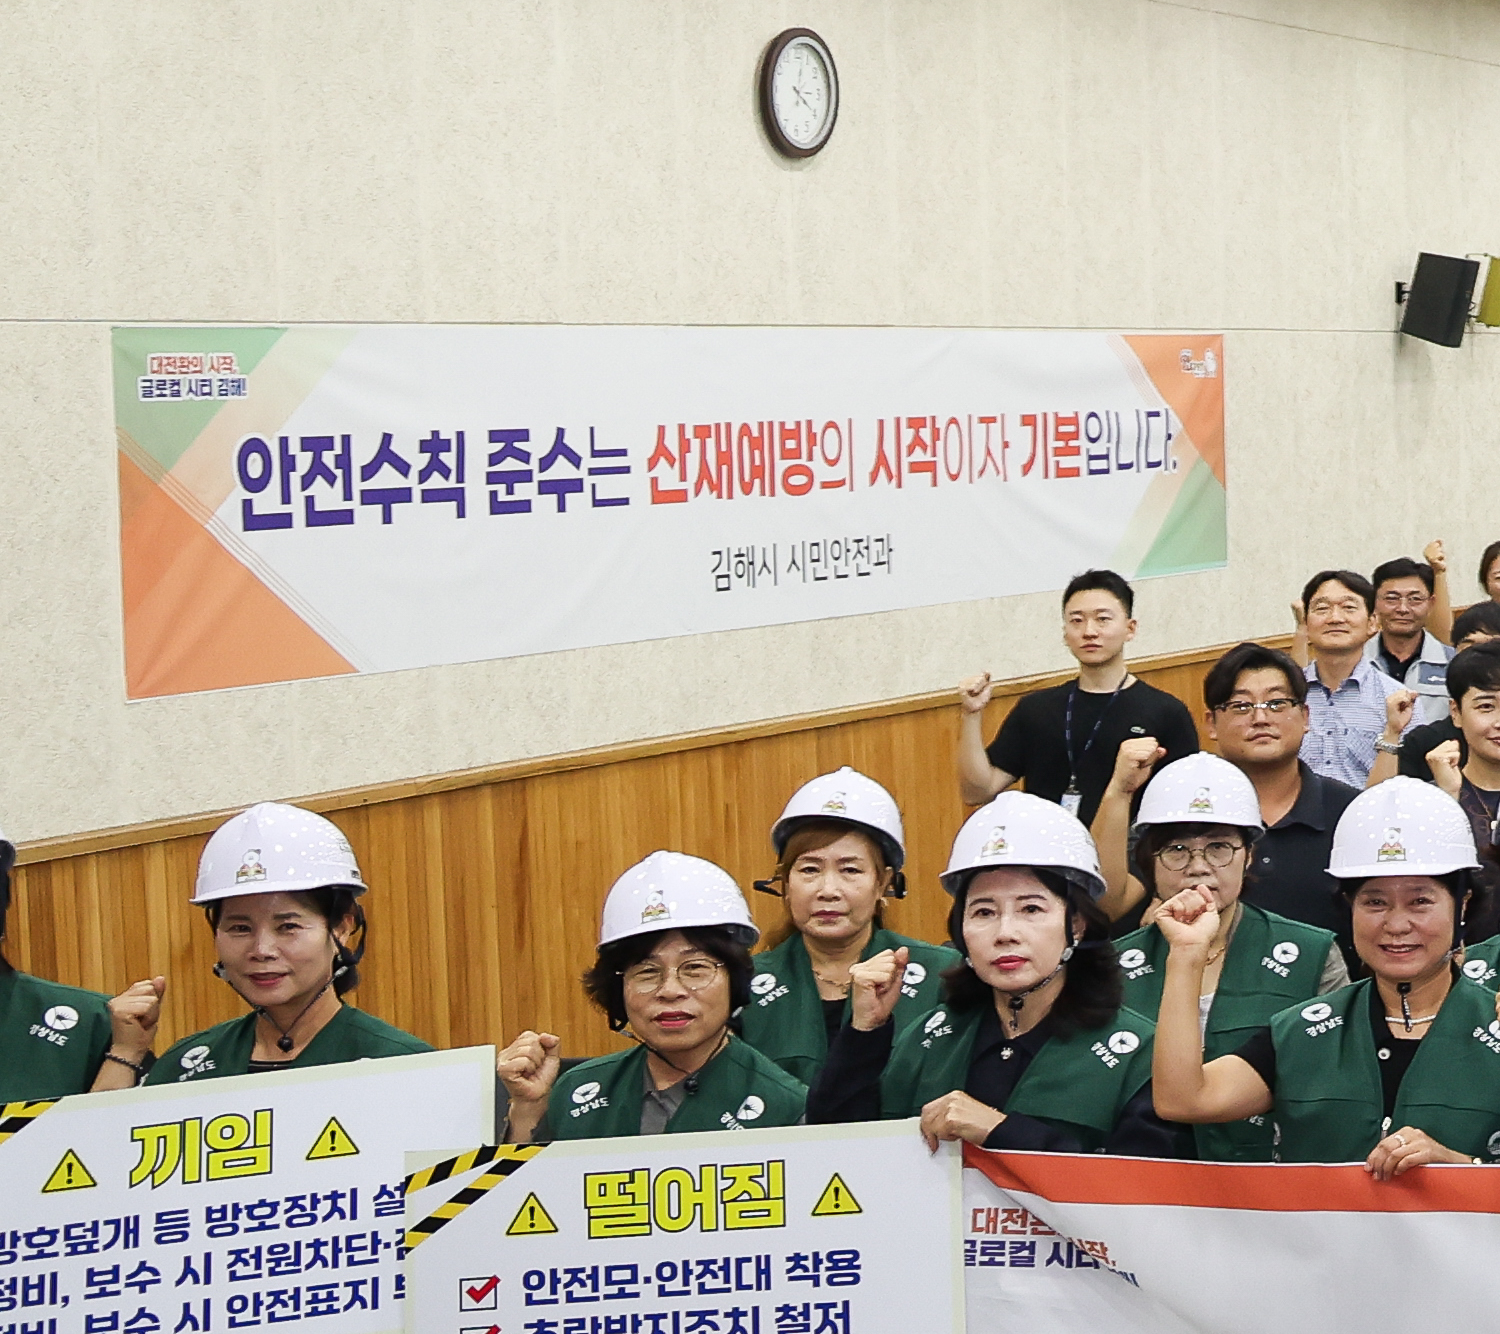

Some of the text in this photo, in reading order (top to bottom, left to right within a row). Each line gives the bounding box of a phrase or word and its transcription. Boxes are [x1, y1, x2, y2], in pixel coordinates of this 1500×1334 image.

[140, 378, 181, 398] 글로컬
[186, 378, 212, 397] 시티
[237, 407, 1179, 532] 안전수칙 준수는 산재예방의 시작이자 기본입니다.
[710, 532, 894, 592] 김해시 시민안전과
[1305, 1015, 1344, 1037] 경상남도
[570, 1097, 610, 1118] 경상남도
[128, 1108, 274, 1190] 끼임
[153, 1208, 191, 1244] 등
[204, 1187, 359, 1240] 방호장치
[583, 1159, 786, 1240] 떨어짐
[83, 1261, 163, 1301] 보수
[175, 1255, 213, 1292] 시
[225, 1273, 381, 1325] 안전표지
[521, 1248, 863, 1308] 안전모·안전대 착용
